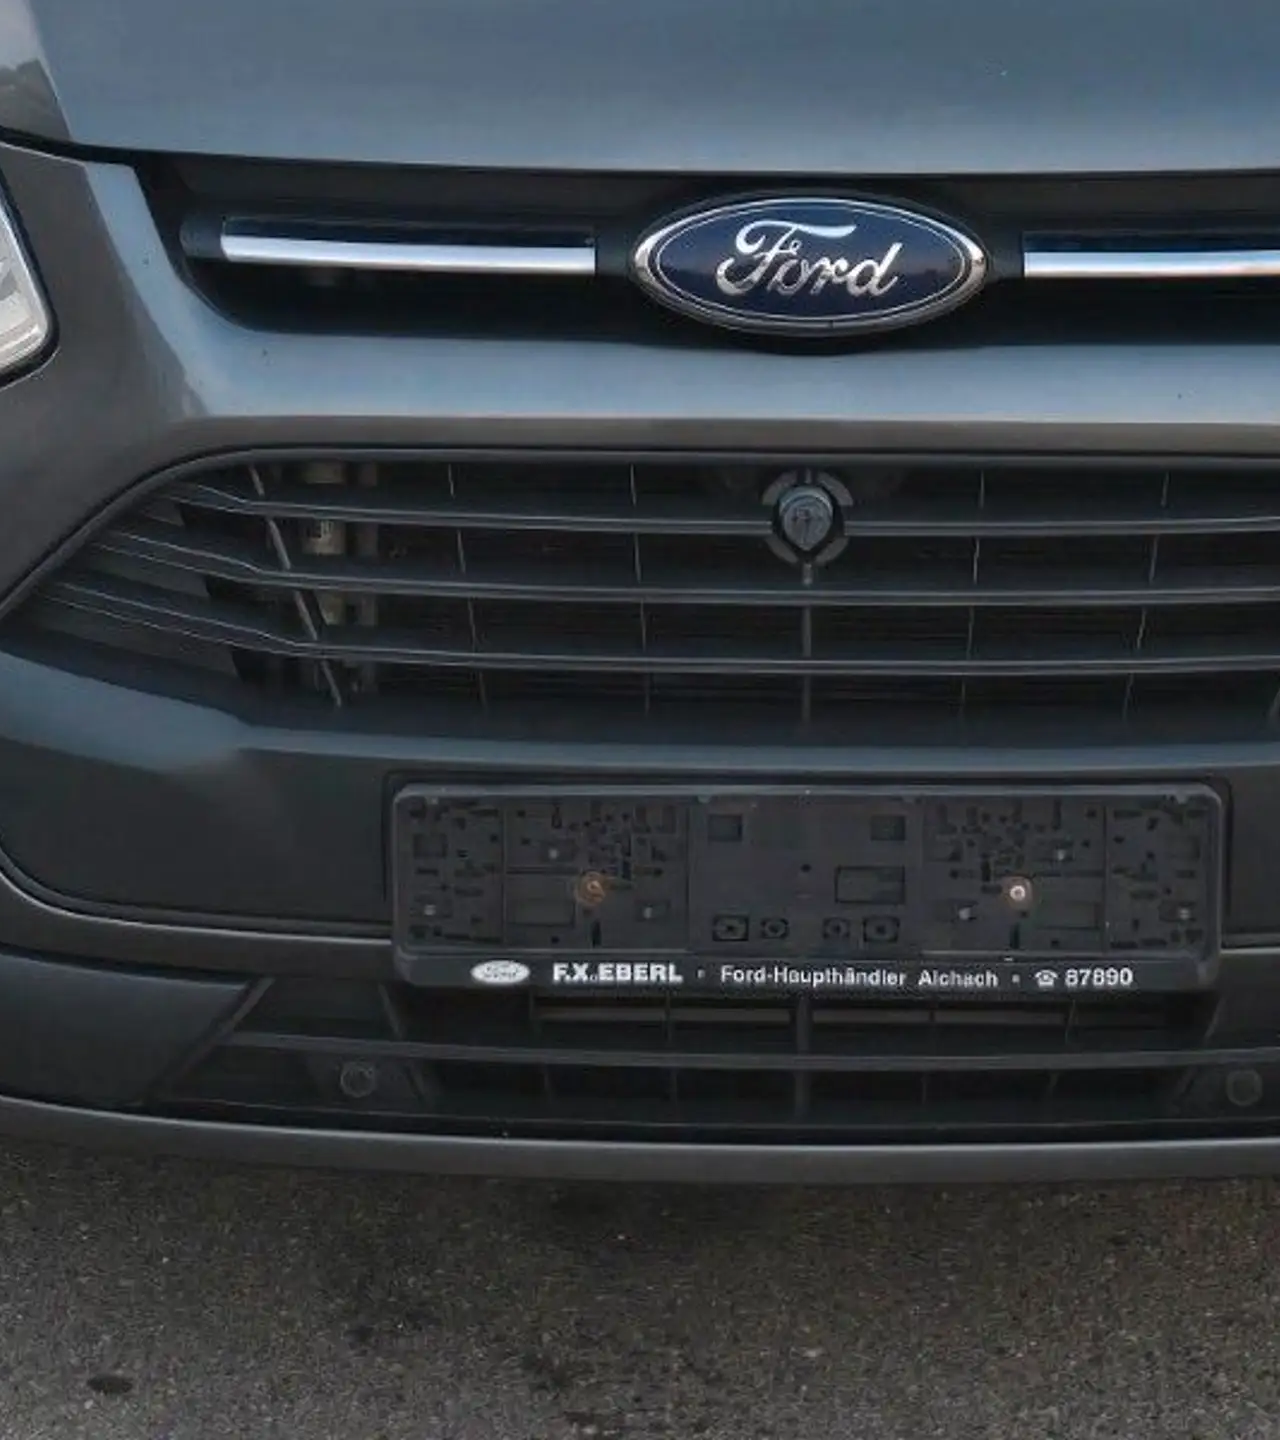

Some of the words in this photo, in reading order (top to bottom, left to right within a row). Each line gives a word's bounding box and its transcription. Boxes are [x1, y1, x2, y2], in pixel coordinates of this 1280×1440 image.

[715, 219, 903, 297] Ford
[721, 964, 908, 988] Ford-Haupthändler
[1064, 967, 1134, 988] 87890
